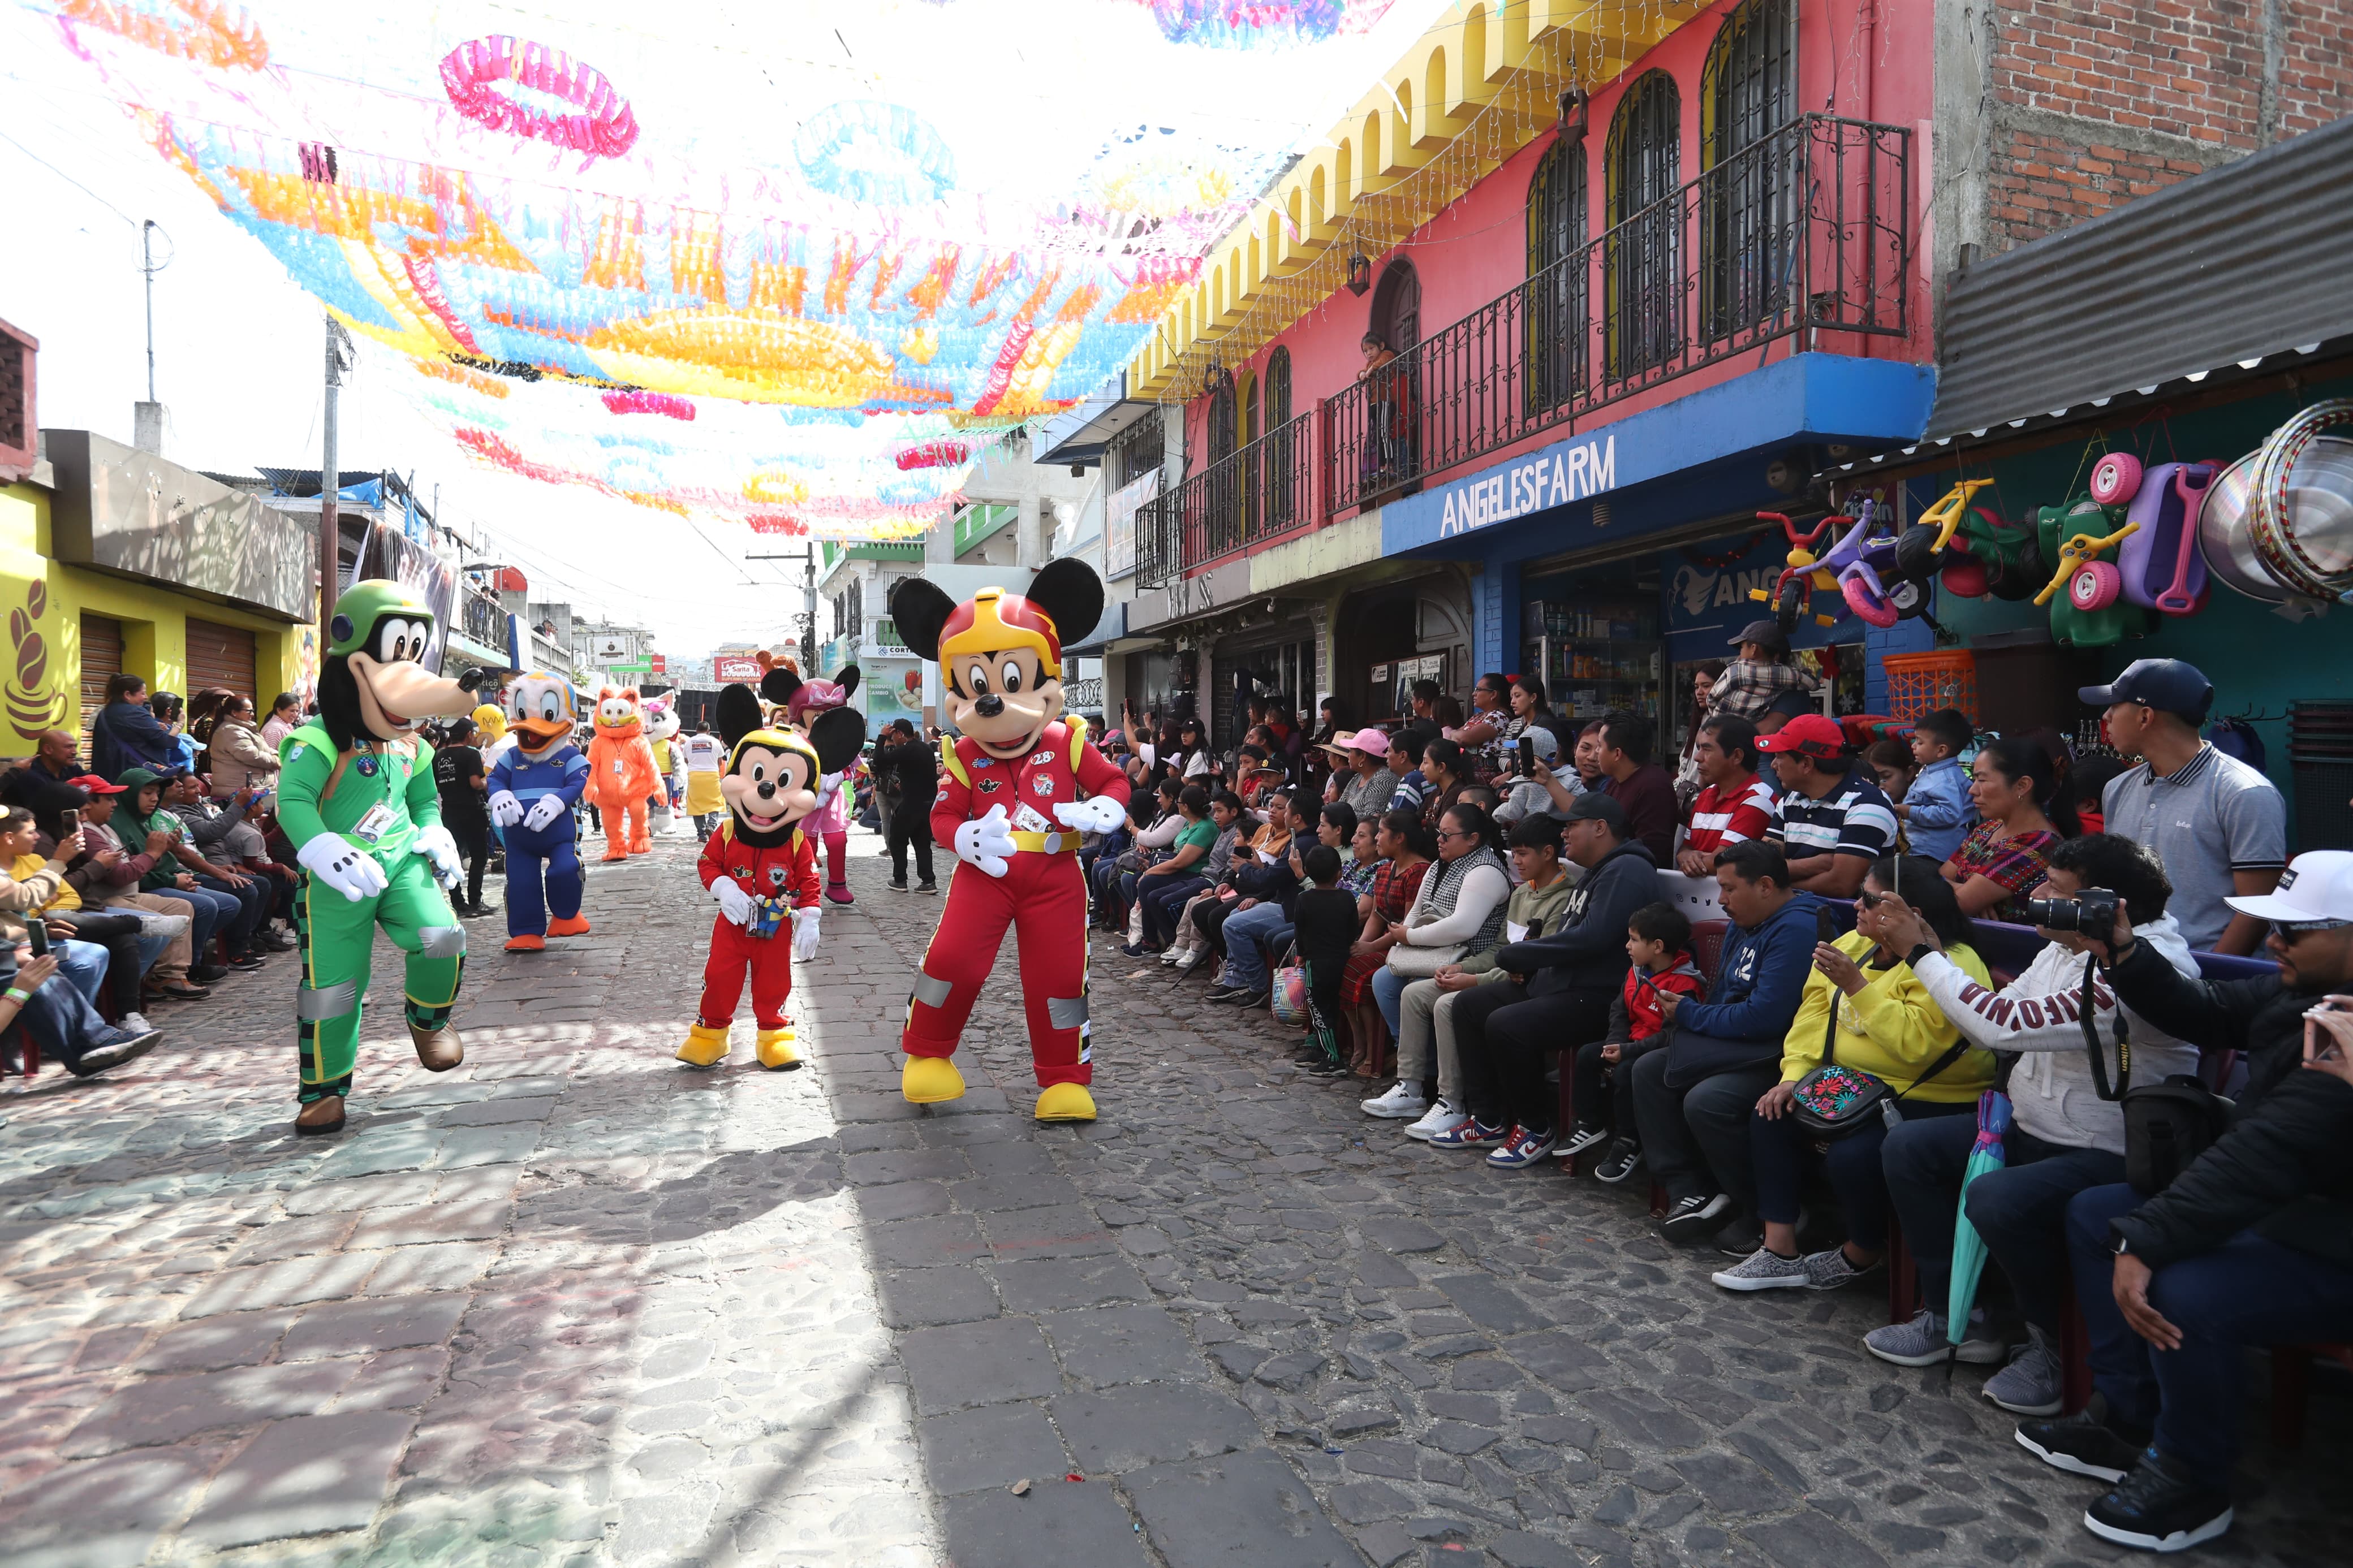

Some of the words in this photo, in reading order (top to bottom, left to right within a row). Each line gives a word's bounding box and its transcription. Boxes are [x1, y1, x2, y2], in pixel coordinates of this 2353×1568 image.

[1440, 434, 1615, 538] ANGELESFARM
[1033, 750, 1052, 766] 28
[1798, 738, 1833, 755] NIKE
[1958, 975, 2115, 1032] AIFONIA
